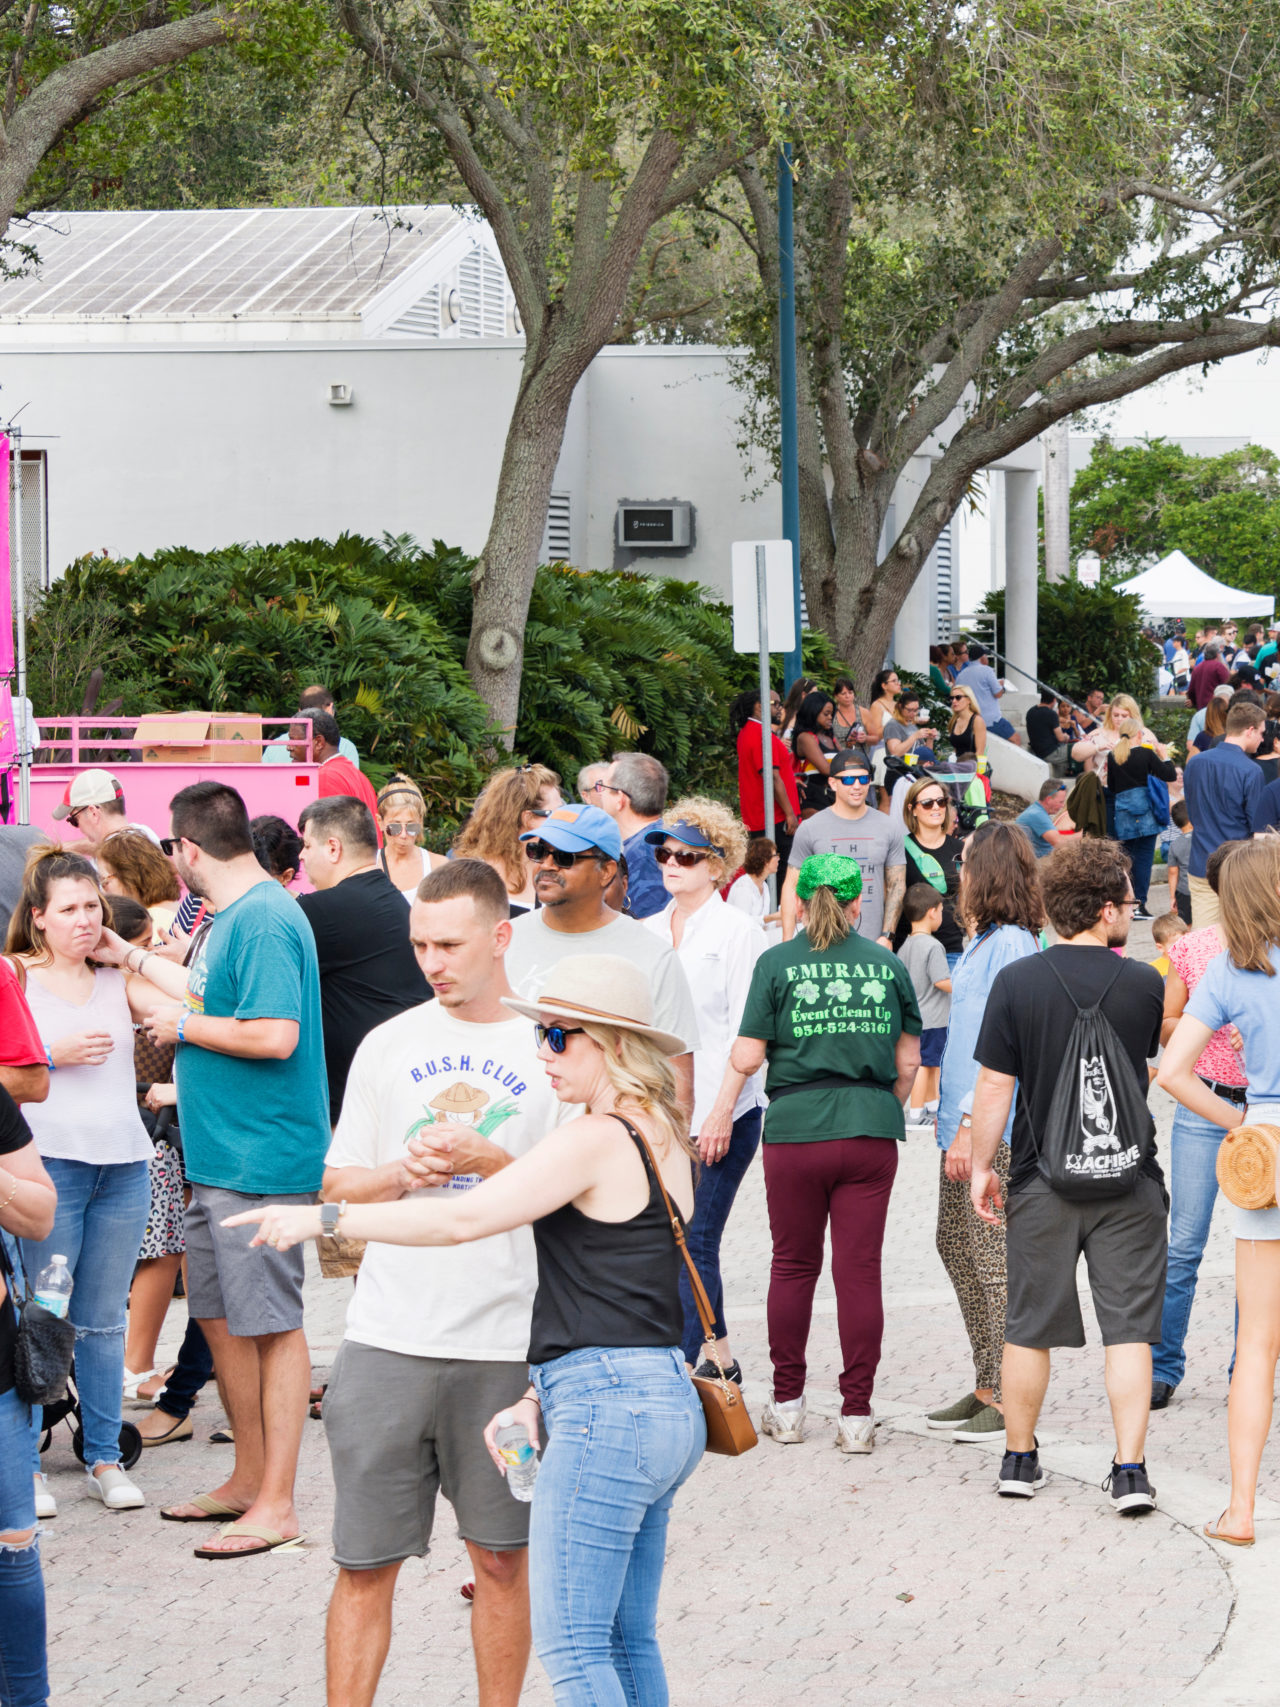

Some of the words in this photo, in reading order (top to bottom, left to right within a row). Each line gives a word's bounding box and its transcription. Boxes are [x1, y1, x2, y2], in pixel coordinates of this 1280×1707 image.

[785, 962, 895, 982] EMERALD
[791, 1008, 830, 1023] Event
[832, 1005, 872, 1018] Clean
[874, 1006, 892, 1021] Up
[793, 1021, 891, 1038] 954-524-3161
[410, 1054, 475, 1083] B.U.S.H.
[482, 1059, 527, 1096] CLUB
[1082, 1144, 1141, 1171] ACHIEVE
